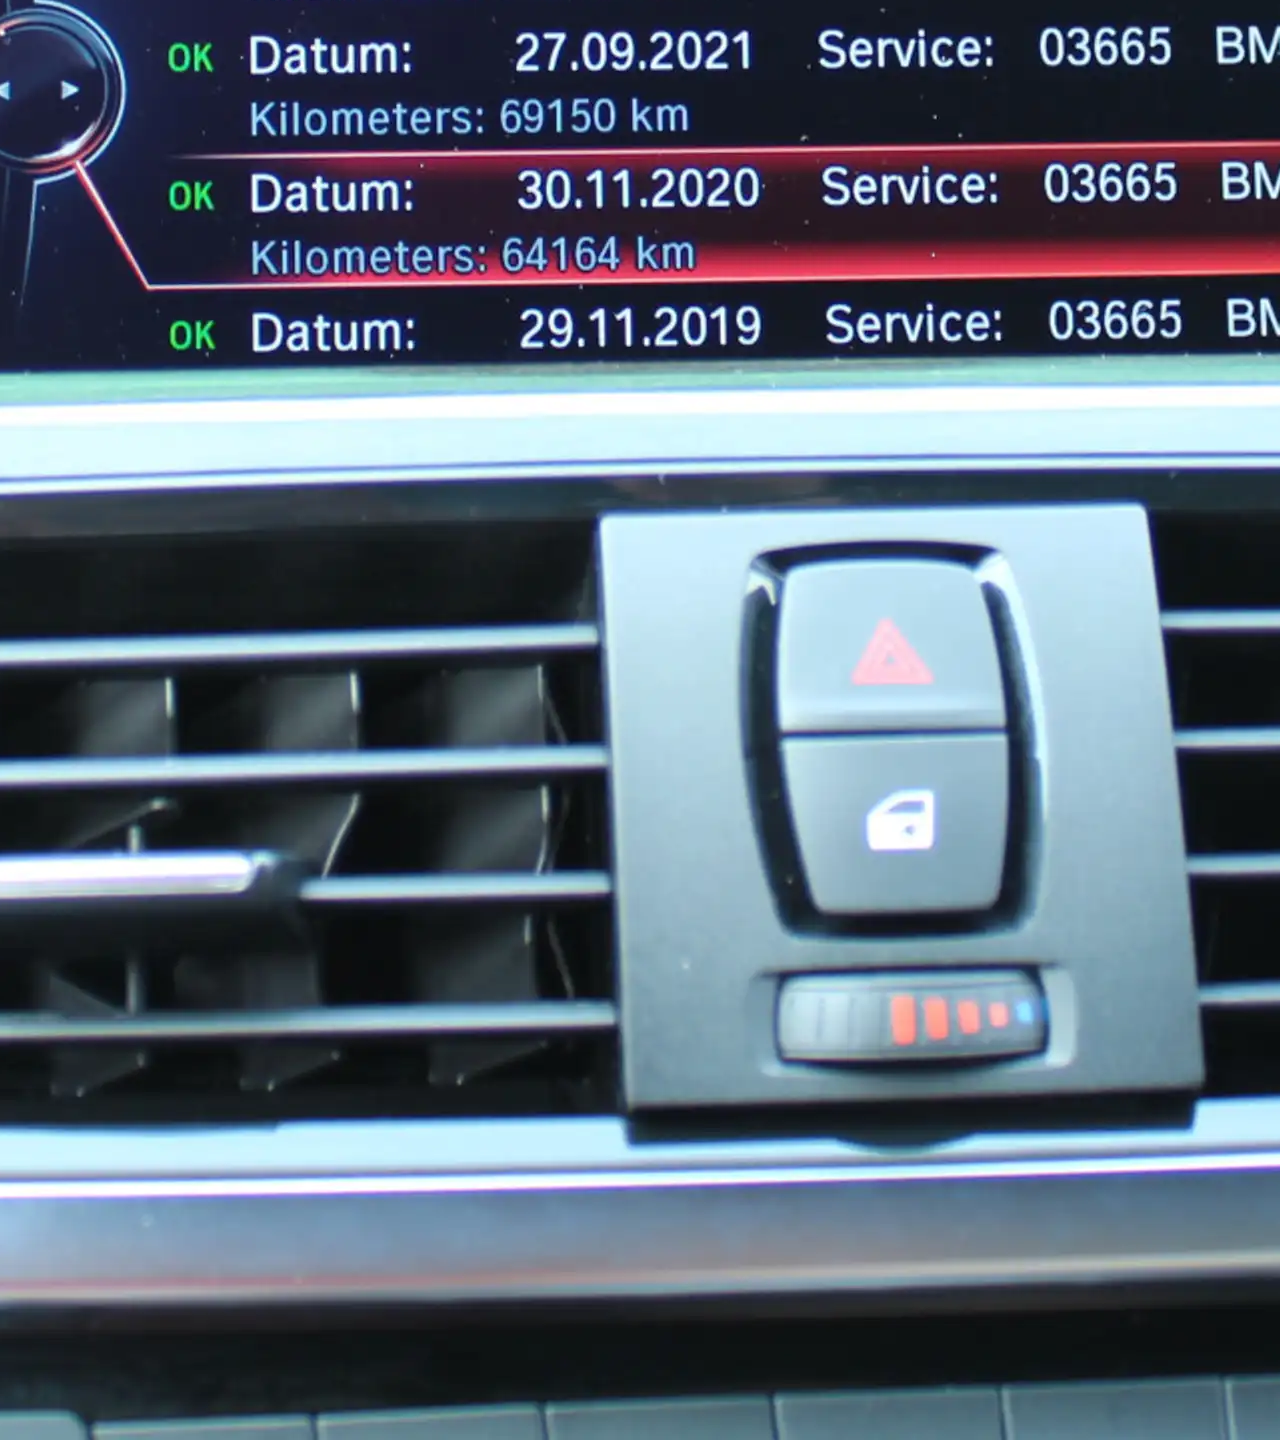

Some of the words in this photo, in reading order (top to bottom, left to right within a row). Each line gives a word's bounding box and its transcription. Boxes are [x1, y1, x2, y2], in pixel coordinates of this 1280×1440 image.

[168, 42, 214, 73] OK
[250, 35, 411, 75] Datum:
[515, 30, 750, 72] 27.09.2021
[818, 28, 993, 69] Service:
[1039, 26, 1172, 67] 03665
[250, 101, 484, 137] Kilometers:
[500, 97, 616, 134] 69150
[631, 97, 688, 132] km
[169, 180, 214, 211] OK
[251, 173, 413, 213] Datum:
[517, 167, 760, 210] 30.11.2020
[822, 165, 998, 206] Service:
[1044, 162, 1177, 203] 03665
[251, 239, 489, 275] Kilometers:
[501, 235, 622, 272] 64164
[637, 235, 694, 270] km
[169, 320, 216, 351] OK
[252, 312, 415, 353] Datum:
[520, 305, 761, 349] 29.11.2019
[825, 303, 1002, 344] Service:
[1049, 299, 1182, 341] 03665
